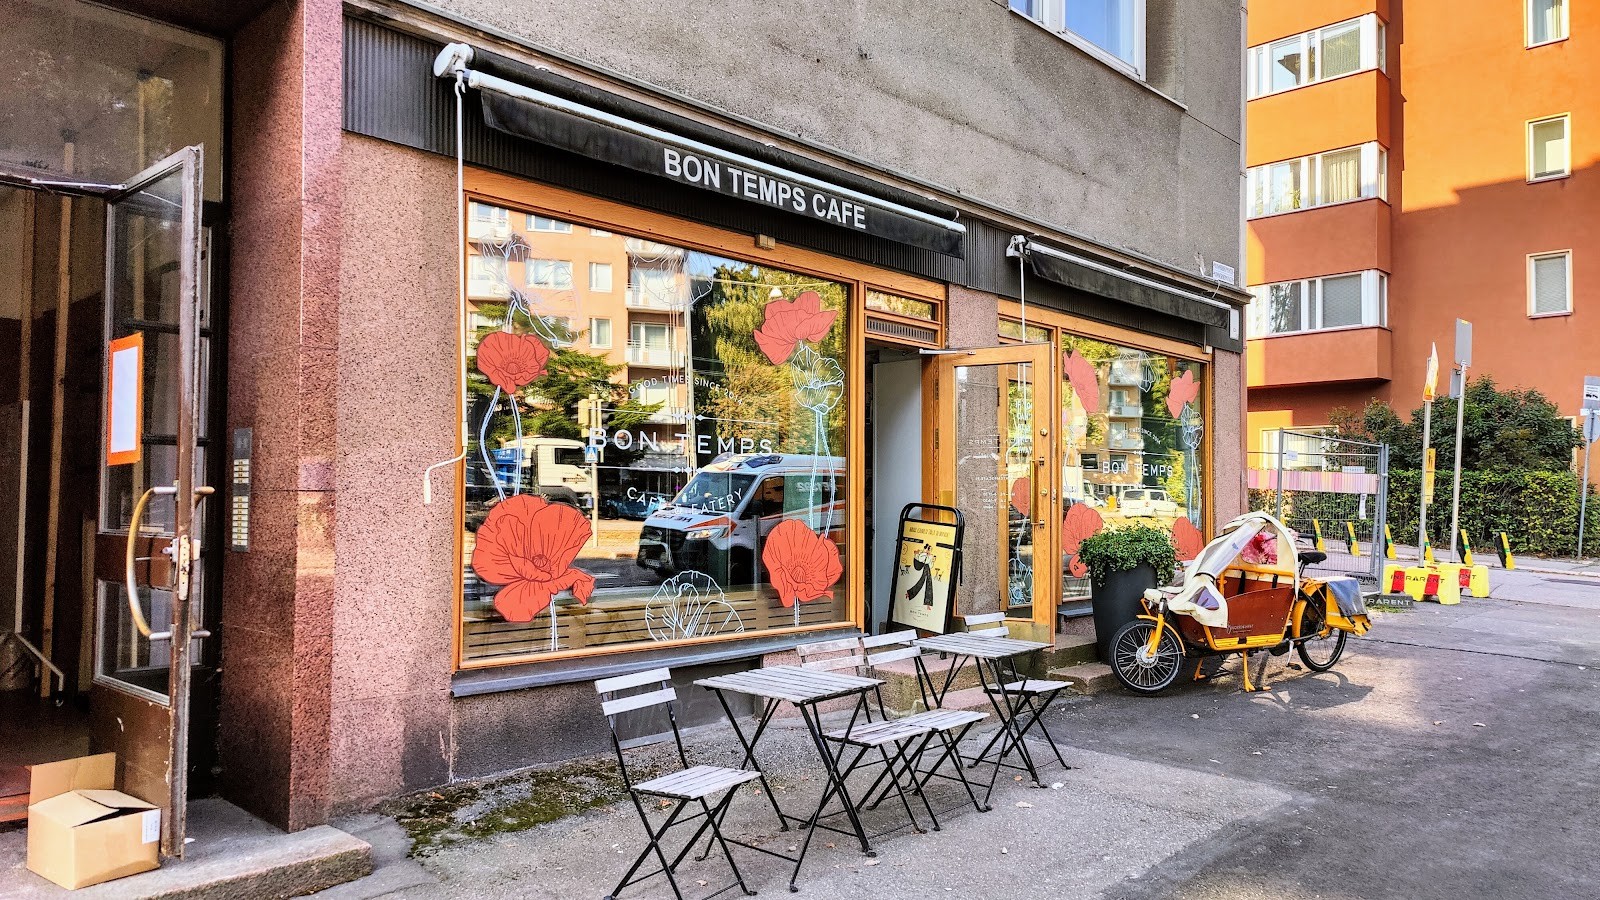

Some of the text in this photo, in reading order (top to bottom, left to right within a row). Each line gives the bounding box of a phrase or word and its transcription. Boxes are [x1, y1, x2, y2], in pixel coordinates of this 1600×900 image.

[663, 147, 867, 230] BON TEMPS CAFE
[628, 377, 658, 395] GOOD
[661, 374, 691, 385] TIMES
[694, 376, 721, 392] SINCE
[588, 427, 773, 457] BON TEMPS
[1102, 461, 1174, 477] BON TEMPS
[691, 487, 742, 515] EATERY
